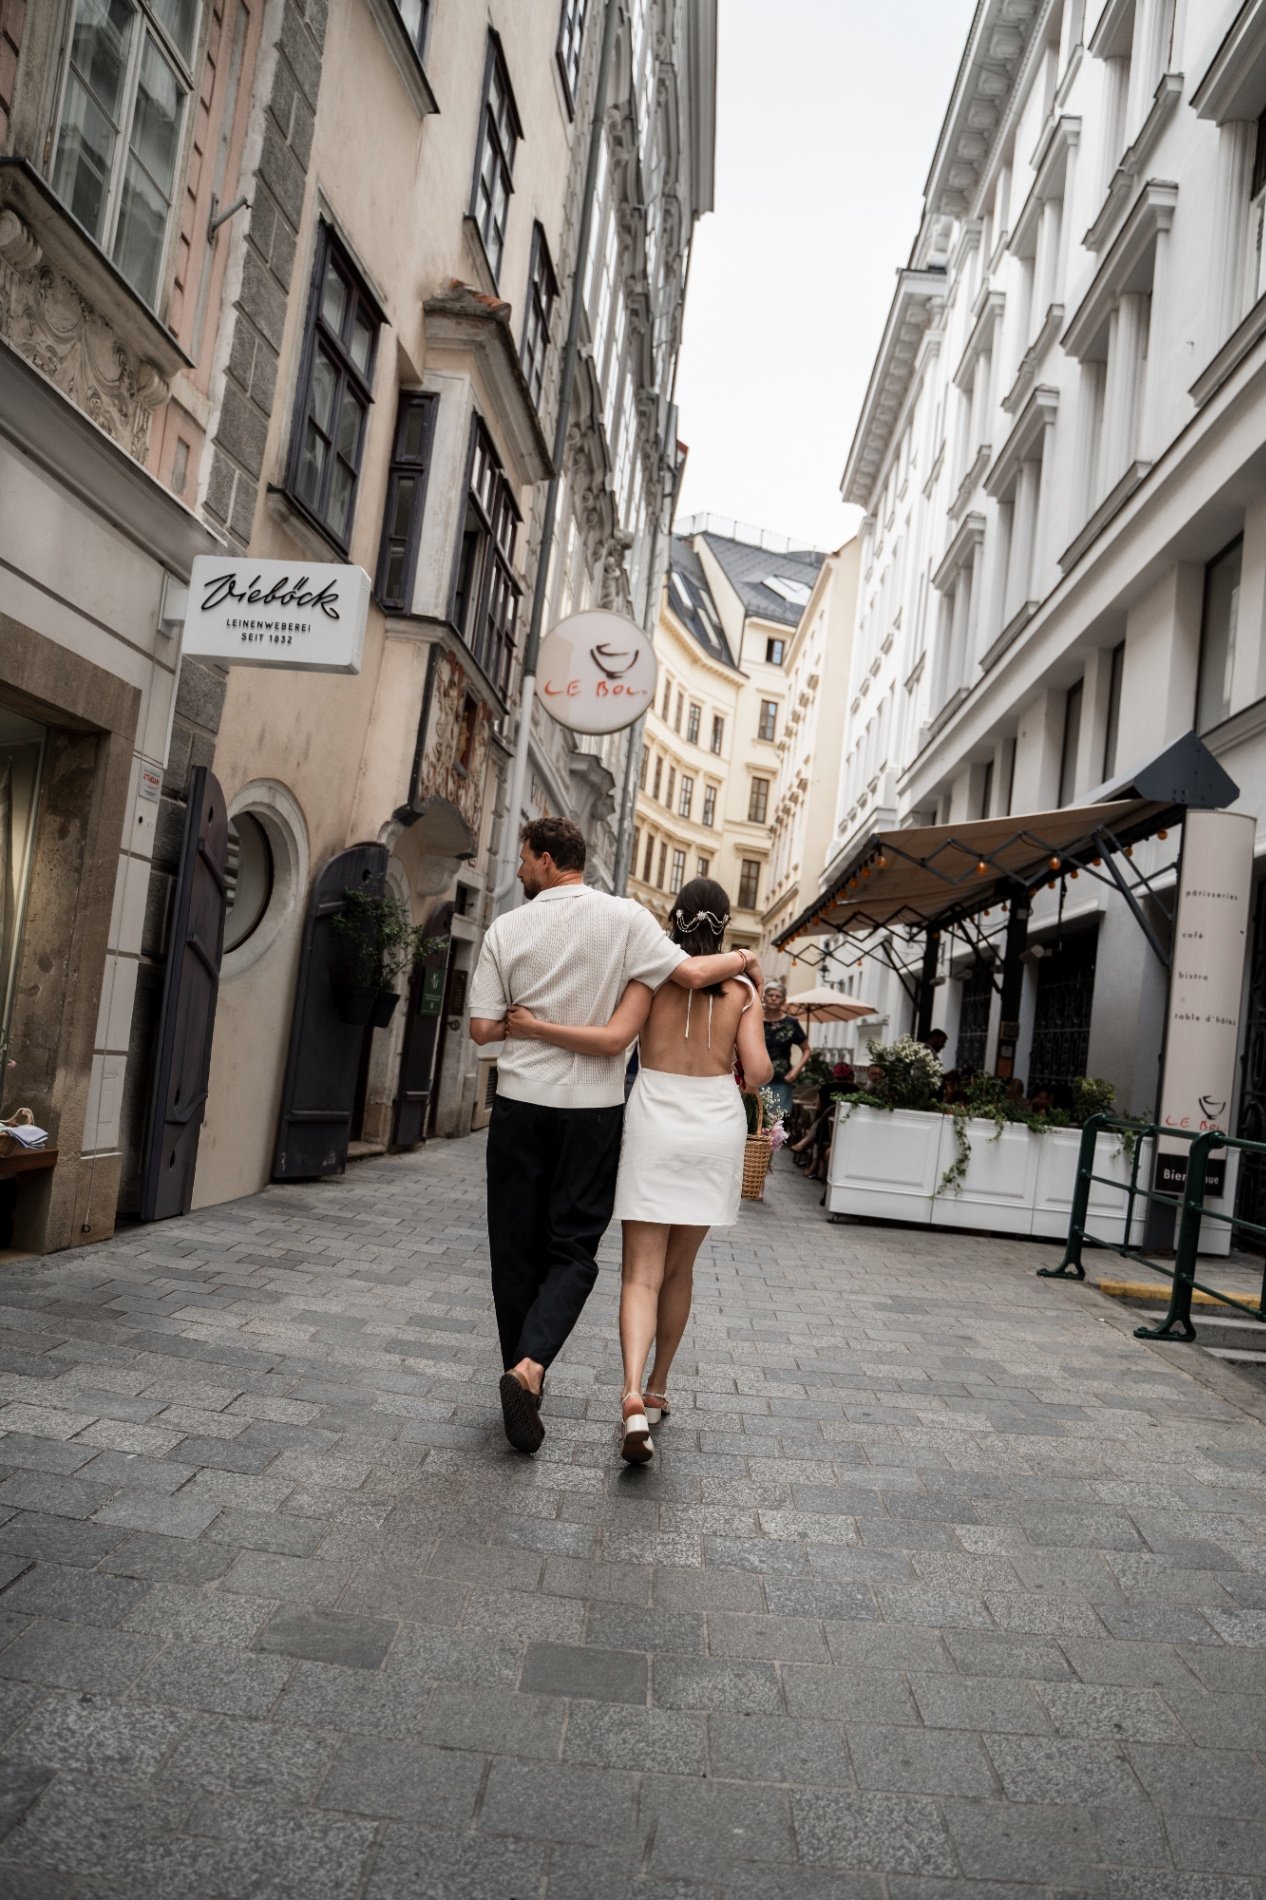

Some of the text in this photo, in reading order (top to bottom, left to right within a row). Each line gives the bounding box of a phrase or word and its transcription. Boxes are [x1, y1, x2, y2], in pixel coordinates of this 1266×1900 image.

[201, 573, 340, 620] Vieböck
[226, 618, 312, 633] LEINENWEBEREI
[241, 632, 294, 645] SEIT 1832
[543, 679, 582, 697] LE
[1185, 889, 1239, 901] pâtisseries
[1182, 930, 1204, 940] café
[1178, 971, 1209, 982] bistro
[1174, 1012, 1201, 1022] table
[1165, 1115, 1191, 1128] LE
[1163, 1168, 1220, 1185] Bienue
